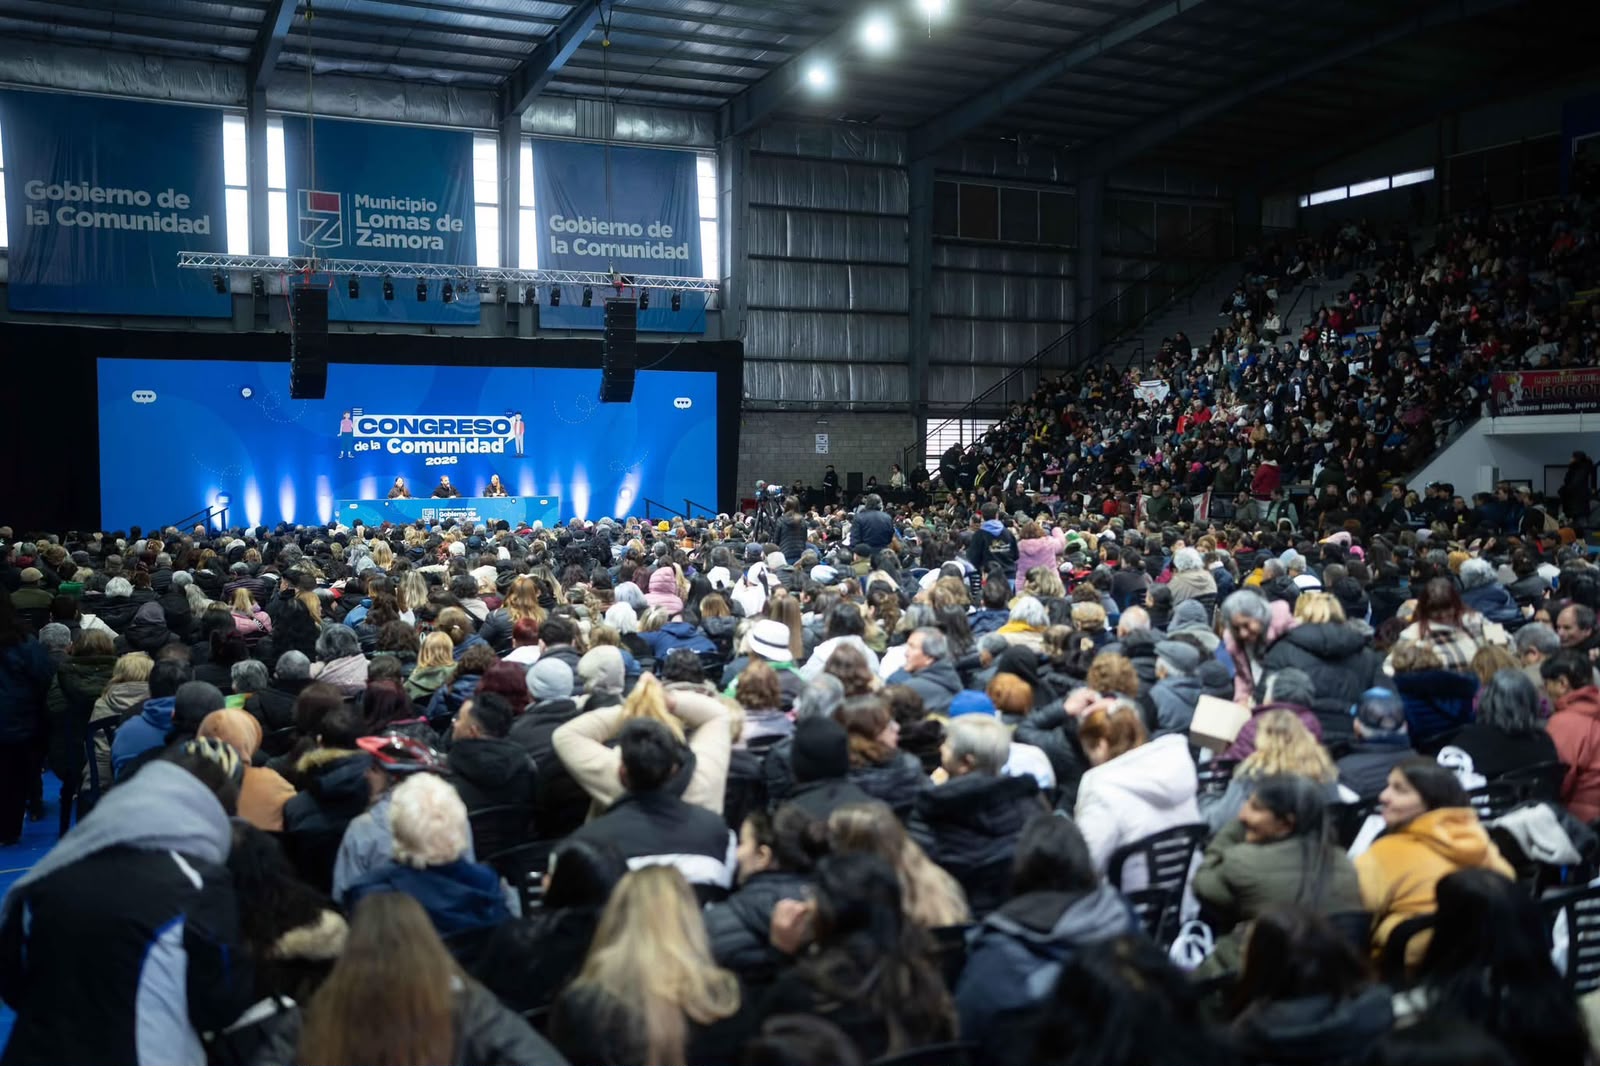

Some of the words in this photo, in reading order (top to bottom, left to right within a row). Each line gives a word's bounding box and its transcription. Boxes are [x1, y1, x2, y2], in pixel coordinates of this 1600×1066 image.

[24, 180, 151, 206] Gobierno
[157, 188, 190, 209] de
[355, 194, 437, 213] Municipio
[25, 205, 49, 226] la
[56, 206, 210, 235] Comunidad
[355, 210, 431, 231] Lomas
[436, 214, 463, 232] de
[550, 215, 643, 237] Gobierno
[647, 220, 673, 238] de
[356, 229, 444, 250] Zamora
[551, 235, 568, 254] la
[573, 238, 689, 259] Comunidad
[358, 418, 511, 435] CONGRESO
[354, 441, 369, 451] de
[370, 440, 381, 450] la
[386, 438, 504, 454] Comunidad
[425, 456, 458, 466] 2026
